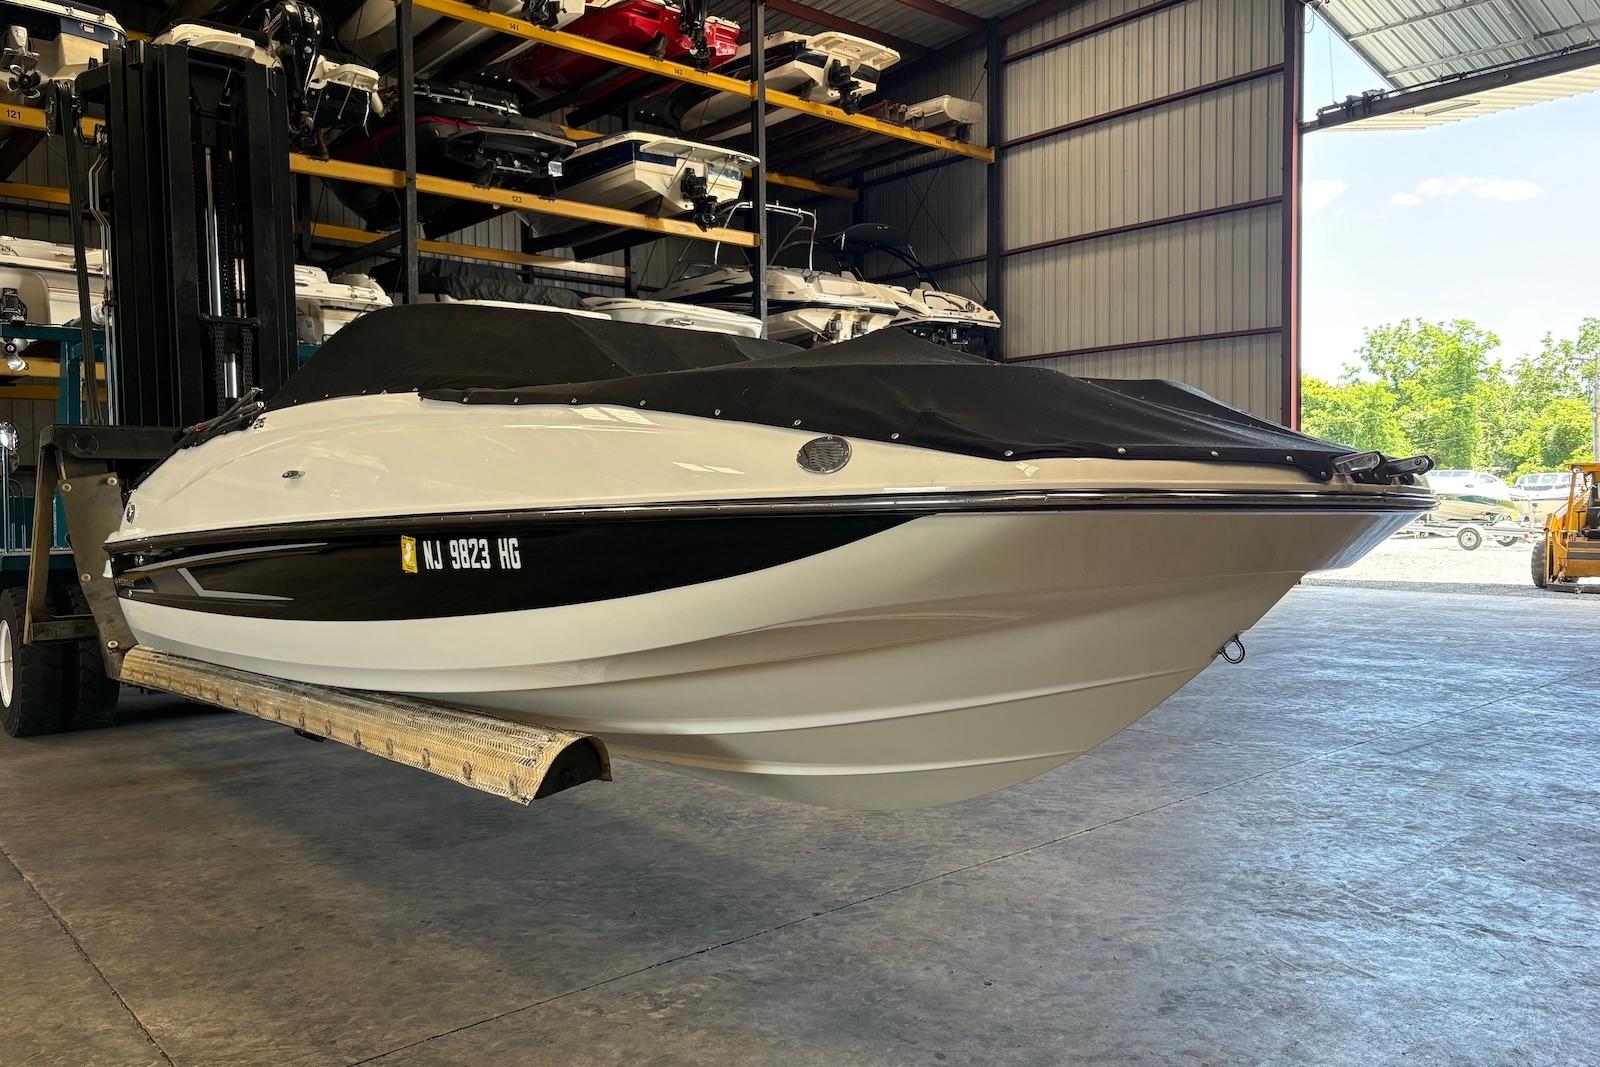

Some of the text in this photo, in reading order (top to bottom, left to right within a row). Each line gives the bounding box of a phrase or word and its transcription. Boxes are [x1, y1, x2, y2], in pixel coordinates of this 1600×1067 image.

[509, 23, 519, 32] 141
[674, 67, 683, 76] 142
[6, 109, 21, 120] 121
[512, 195, 522, 204] 123
[423, 538, 521, 570] NJ 9823 HG
